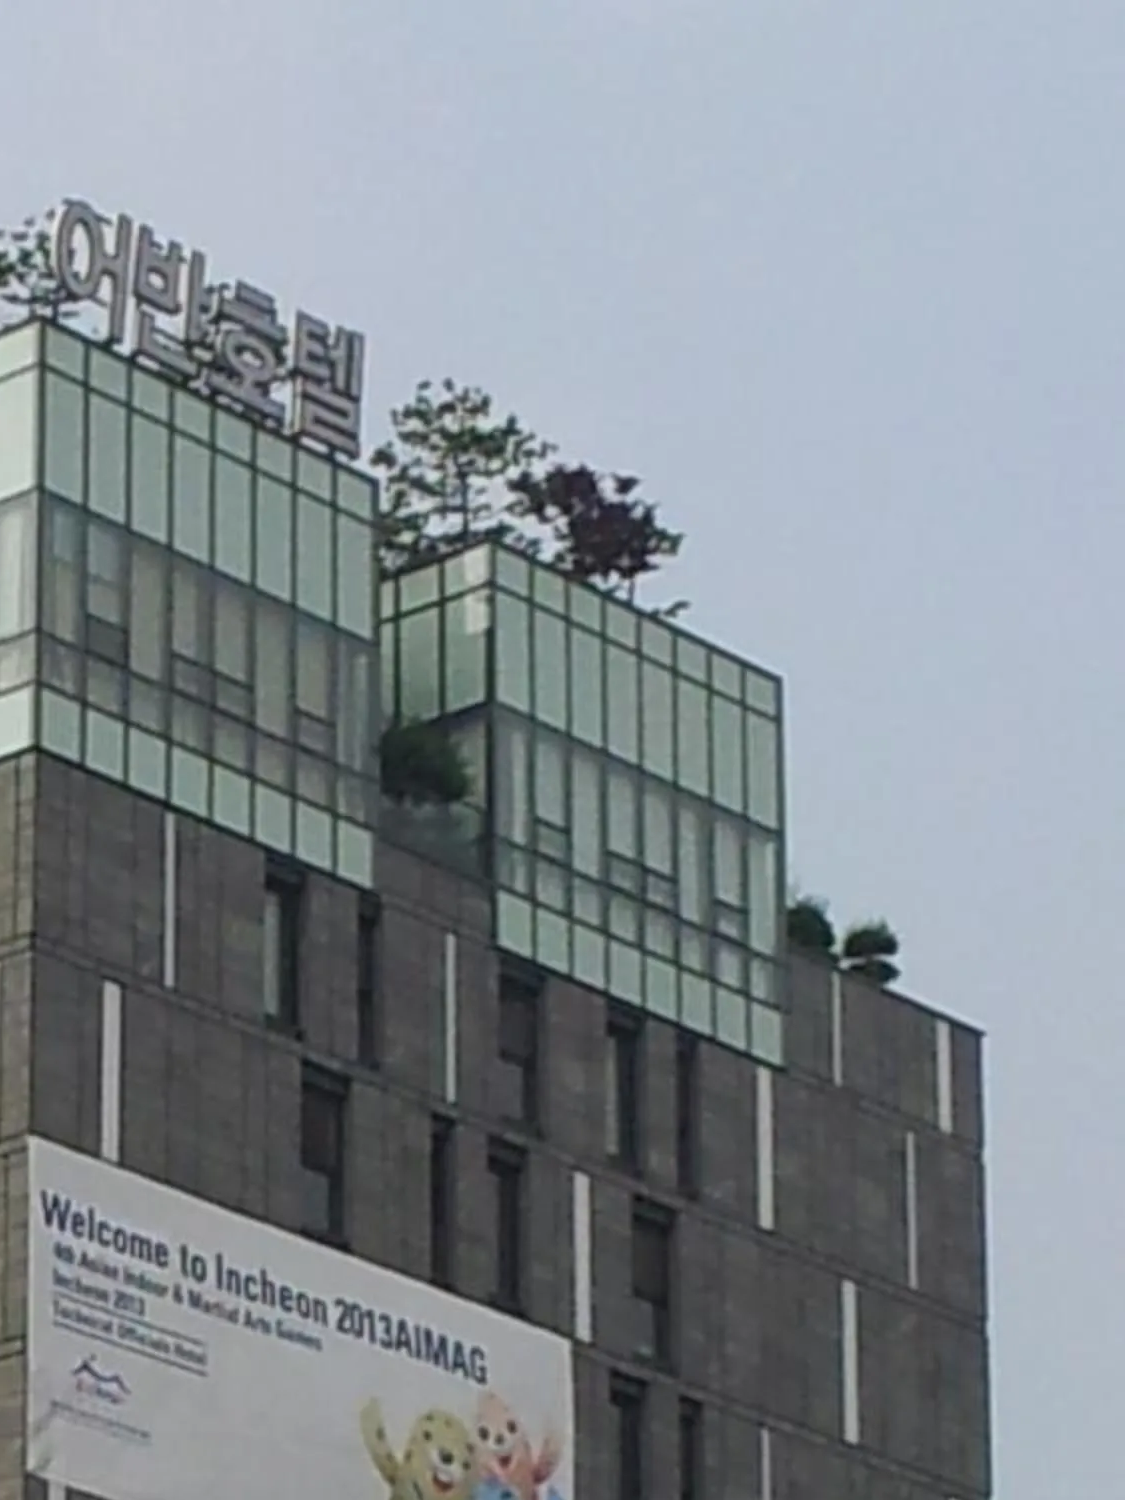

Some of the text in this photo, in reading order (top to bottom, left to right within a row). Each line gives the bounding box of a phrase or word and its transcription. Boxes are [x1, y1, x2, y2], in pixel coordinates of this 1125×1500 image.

[53, 197, 366, 460] 어반호텔
[39, 1188, 488, 1386] Welcome to Incheon 2013AIMAG
[52, 1266, 147, 1317] Incheon 2013
[52, 1297, 114, 1333] Technical
[78, 1251, 119, 1280] Asian
[123, 1265, 169, 1298] Indoor
[172, 1283, 184, 1304] &
[187, 1289, 240, 1325] Martial
[244, 1309, 272, 1336] Arts
[276, 1317, 323, 1351] Games
